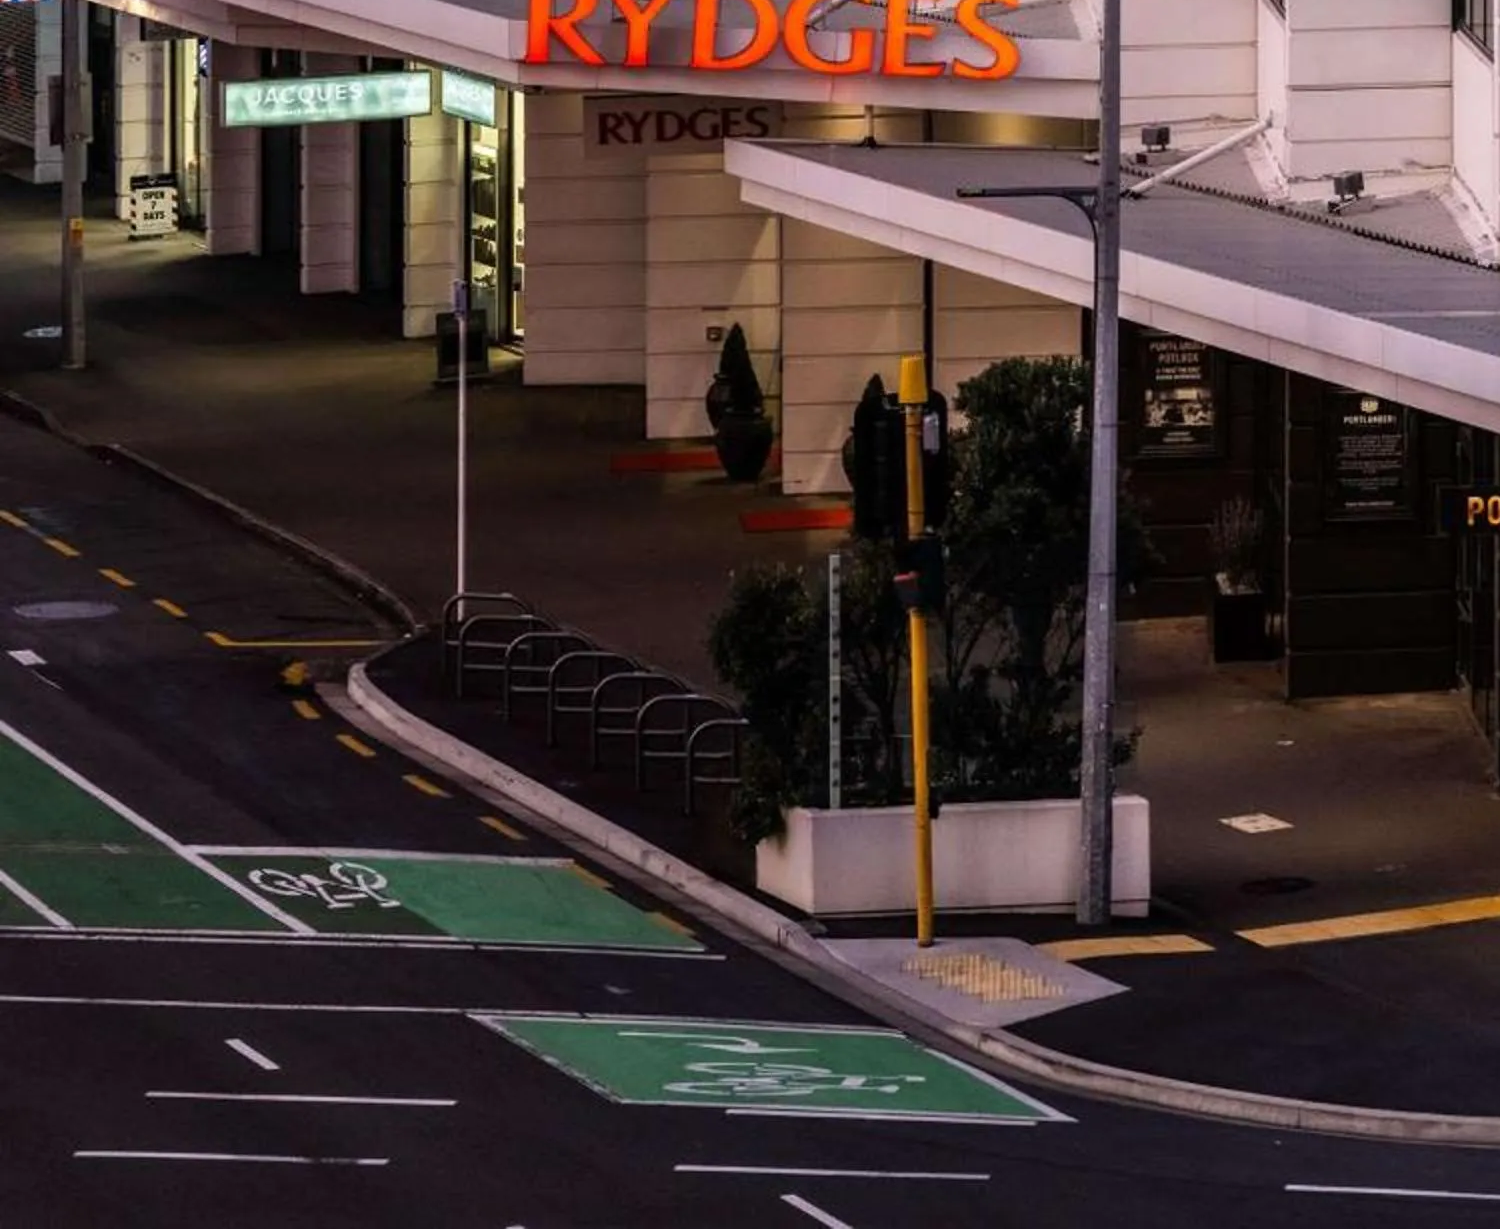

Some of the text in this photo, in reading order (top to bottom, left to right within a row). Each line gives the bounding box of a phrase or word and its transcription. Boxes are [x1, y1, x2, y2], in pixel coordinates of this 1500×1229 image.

[252, 82, 364, 105] JACQUES
[597, 106, 769, 145] RYDGES
[142, 191, 165, 200] OPEN
[151, 200, 157, 210] 7
[143, 211, 165, 220] DAYS
